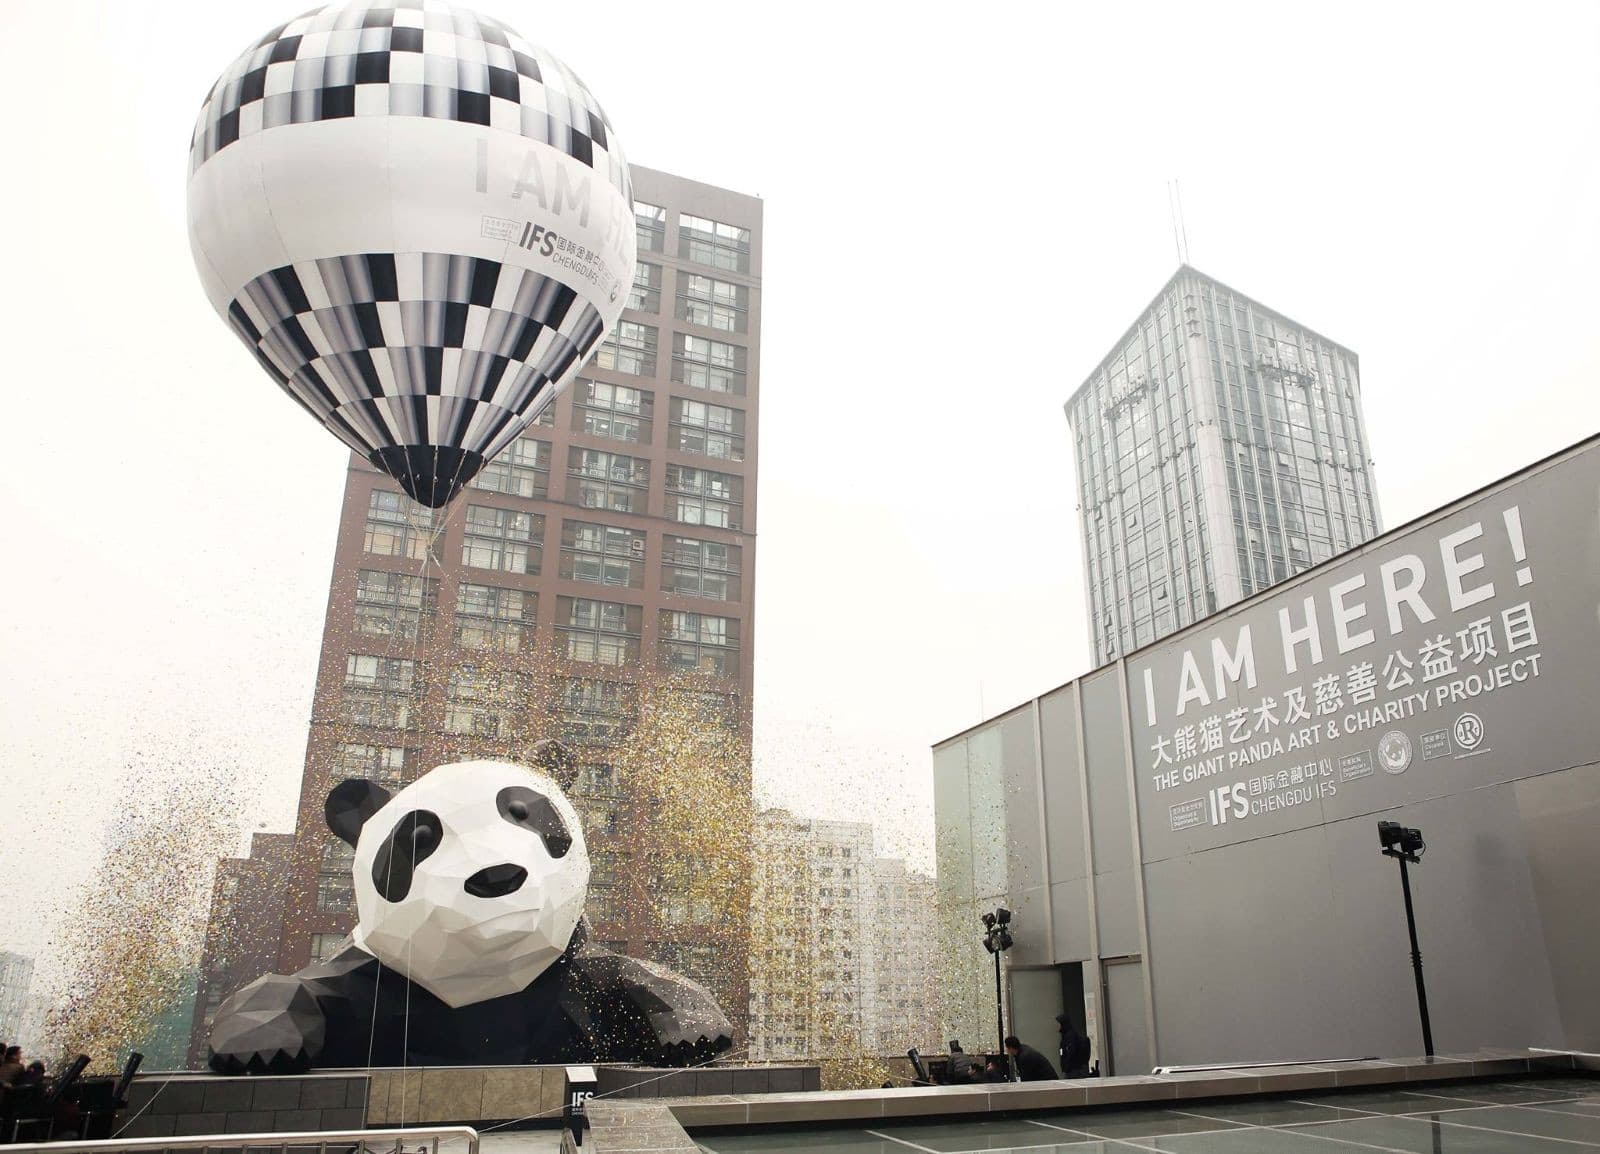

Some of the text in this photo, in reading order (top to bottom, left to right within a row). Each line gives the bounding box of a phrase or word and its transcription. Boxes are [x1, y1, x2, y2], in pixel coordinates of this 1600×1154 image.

[476, 138, 488, 193] I
[511, 149, 592, 229] AM
[519, 221, 557, 257] IFS
[1143, 505, 1534, 727] I AM HERE!
[1150, 602, 1539, 771] 大熊猫艺术及慈善公益项目
[1153, 654, 1542, 792] THE GIANT PANDA ART & CHARITY PROJECT
[1209, 782, 1250, 825] IFS
[1249, 758, 1334, 796] 国际金融中心
[1251, 781, 1337, 815] CHENGDU IFS
